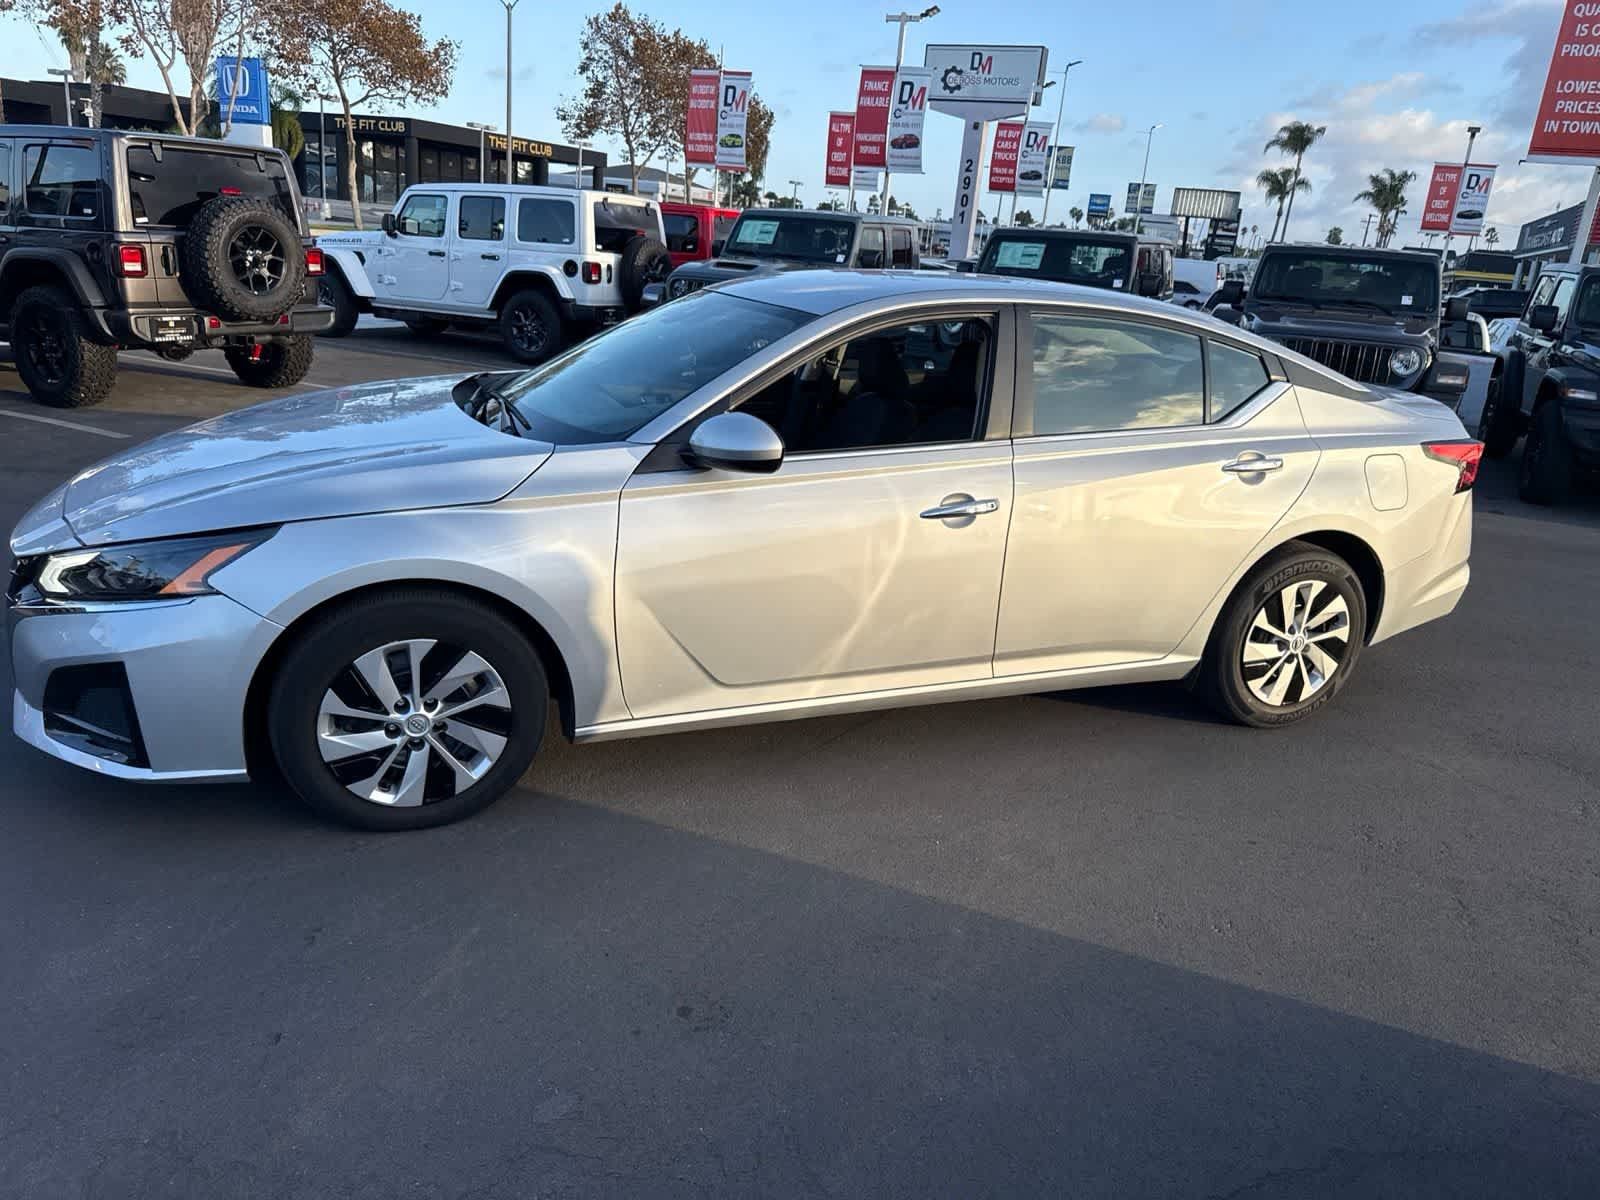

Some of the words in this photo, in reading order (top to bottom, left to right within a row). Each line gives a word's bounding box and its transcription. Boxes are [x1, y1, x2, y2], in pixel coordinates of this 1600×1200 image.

[1575, 23, 1589, 37] IS
[863, 80, 889, 91] FINANCE
[983, 76, 1020, 87] MOTORS
[723, 84, 748, 113] DM
[859, 95, 890, 108] AVAILABLE
[898, 80, 927, 111] DM
[220, 104, 259, 113] HNDA
[359, 119, 377, 131] FIT
[378, 120, 406, 133] CLUB
[1543, 119, 1560, 133] IN
[998, 129, 1008, 138] WE
[1007, 130, 1021, 139] BUY
[512, 139, 528, 153] FIT
[529, 142, 553, 157] CLUB
[996, 141, 1012, 150] CARS
[1026, 131, 1049, 153] DM
[993, 152, 1017, 161] TRUCKS
[1466, 173, 1491, 195] DM
[1439, 186, 1448, 196] OF
